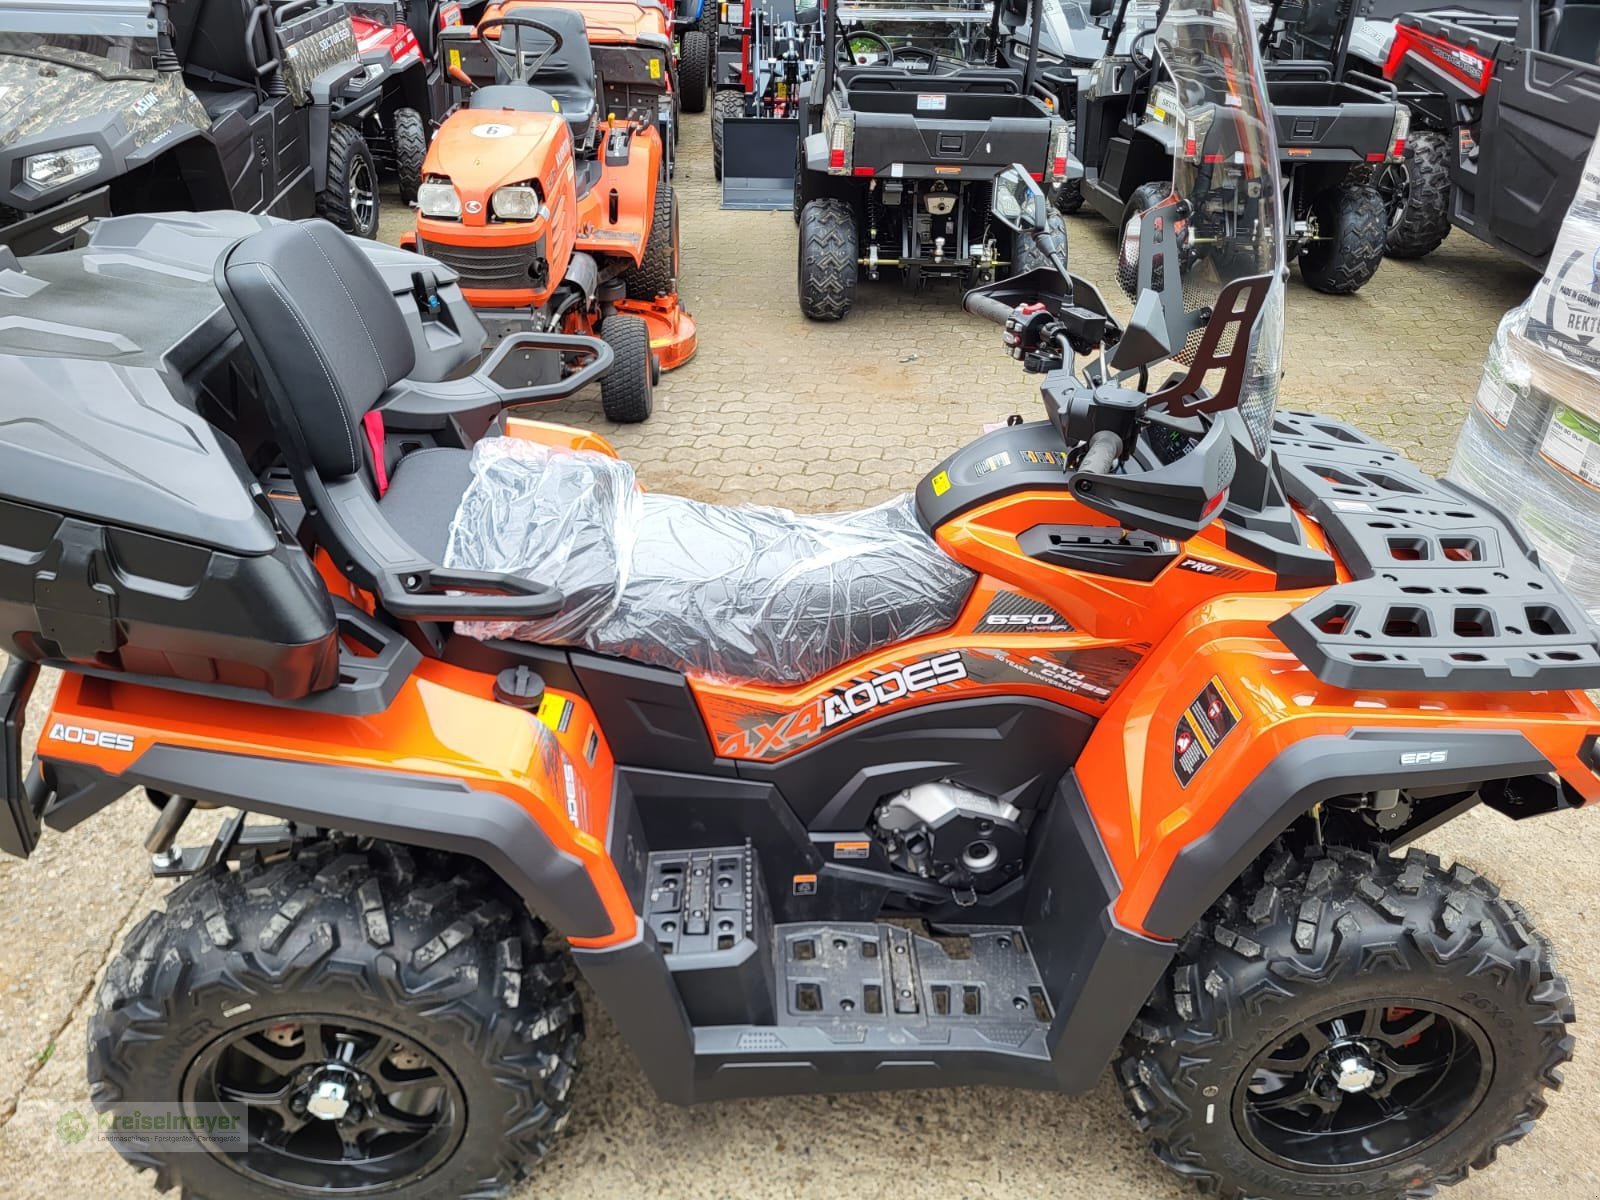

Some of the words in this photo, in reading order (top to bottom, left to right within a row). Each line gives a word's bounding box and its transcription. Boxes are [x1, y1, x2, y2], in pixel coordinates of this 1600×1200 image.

[1181, 559, 1217, 573] PRO
[986, 614, 1055, 625] 650
[1005, 658, 1029, 674] YEARS
[823, 650, 969, 728] AODES
[1040, 668, 1111, 695] CROSS
[49, 723, 135, 752] AODES
[1401, 751, 1448, 765] EPS
